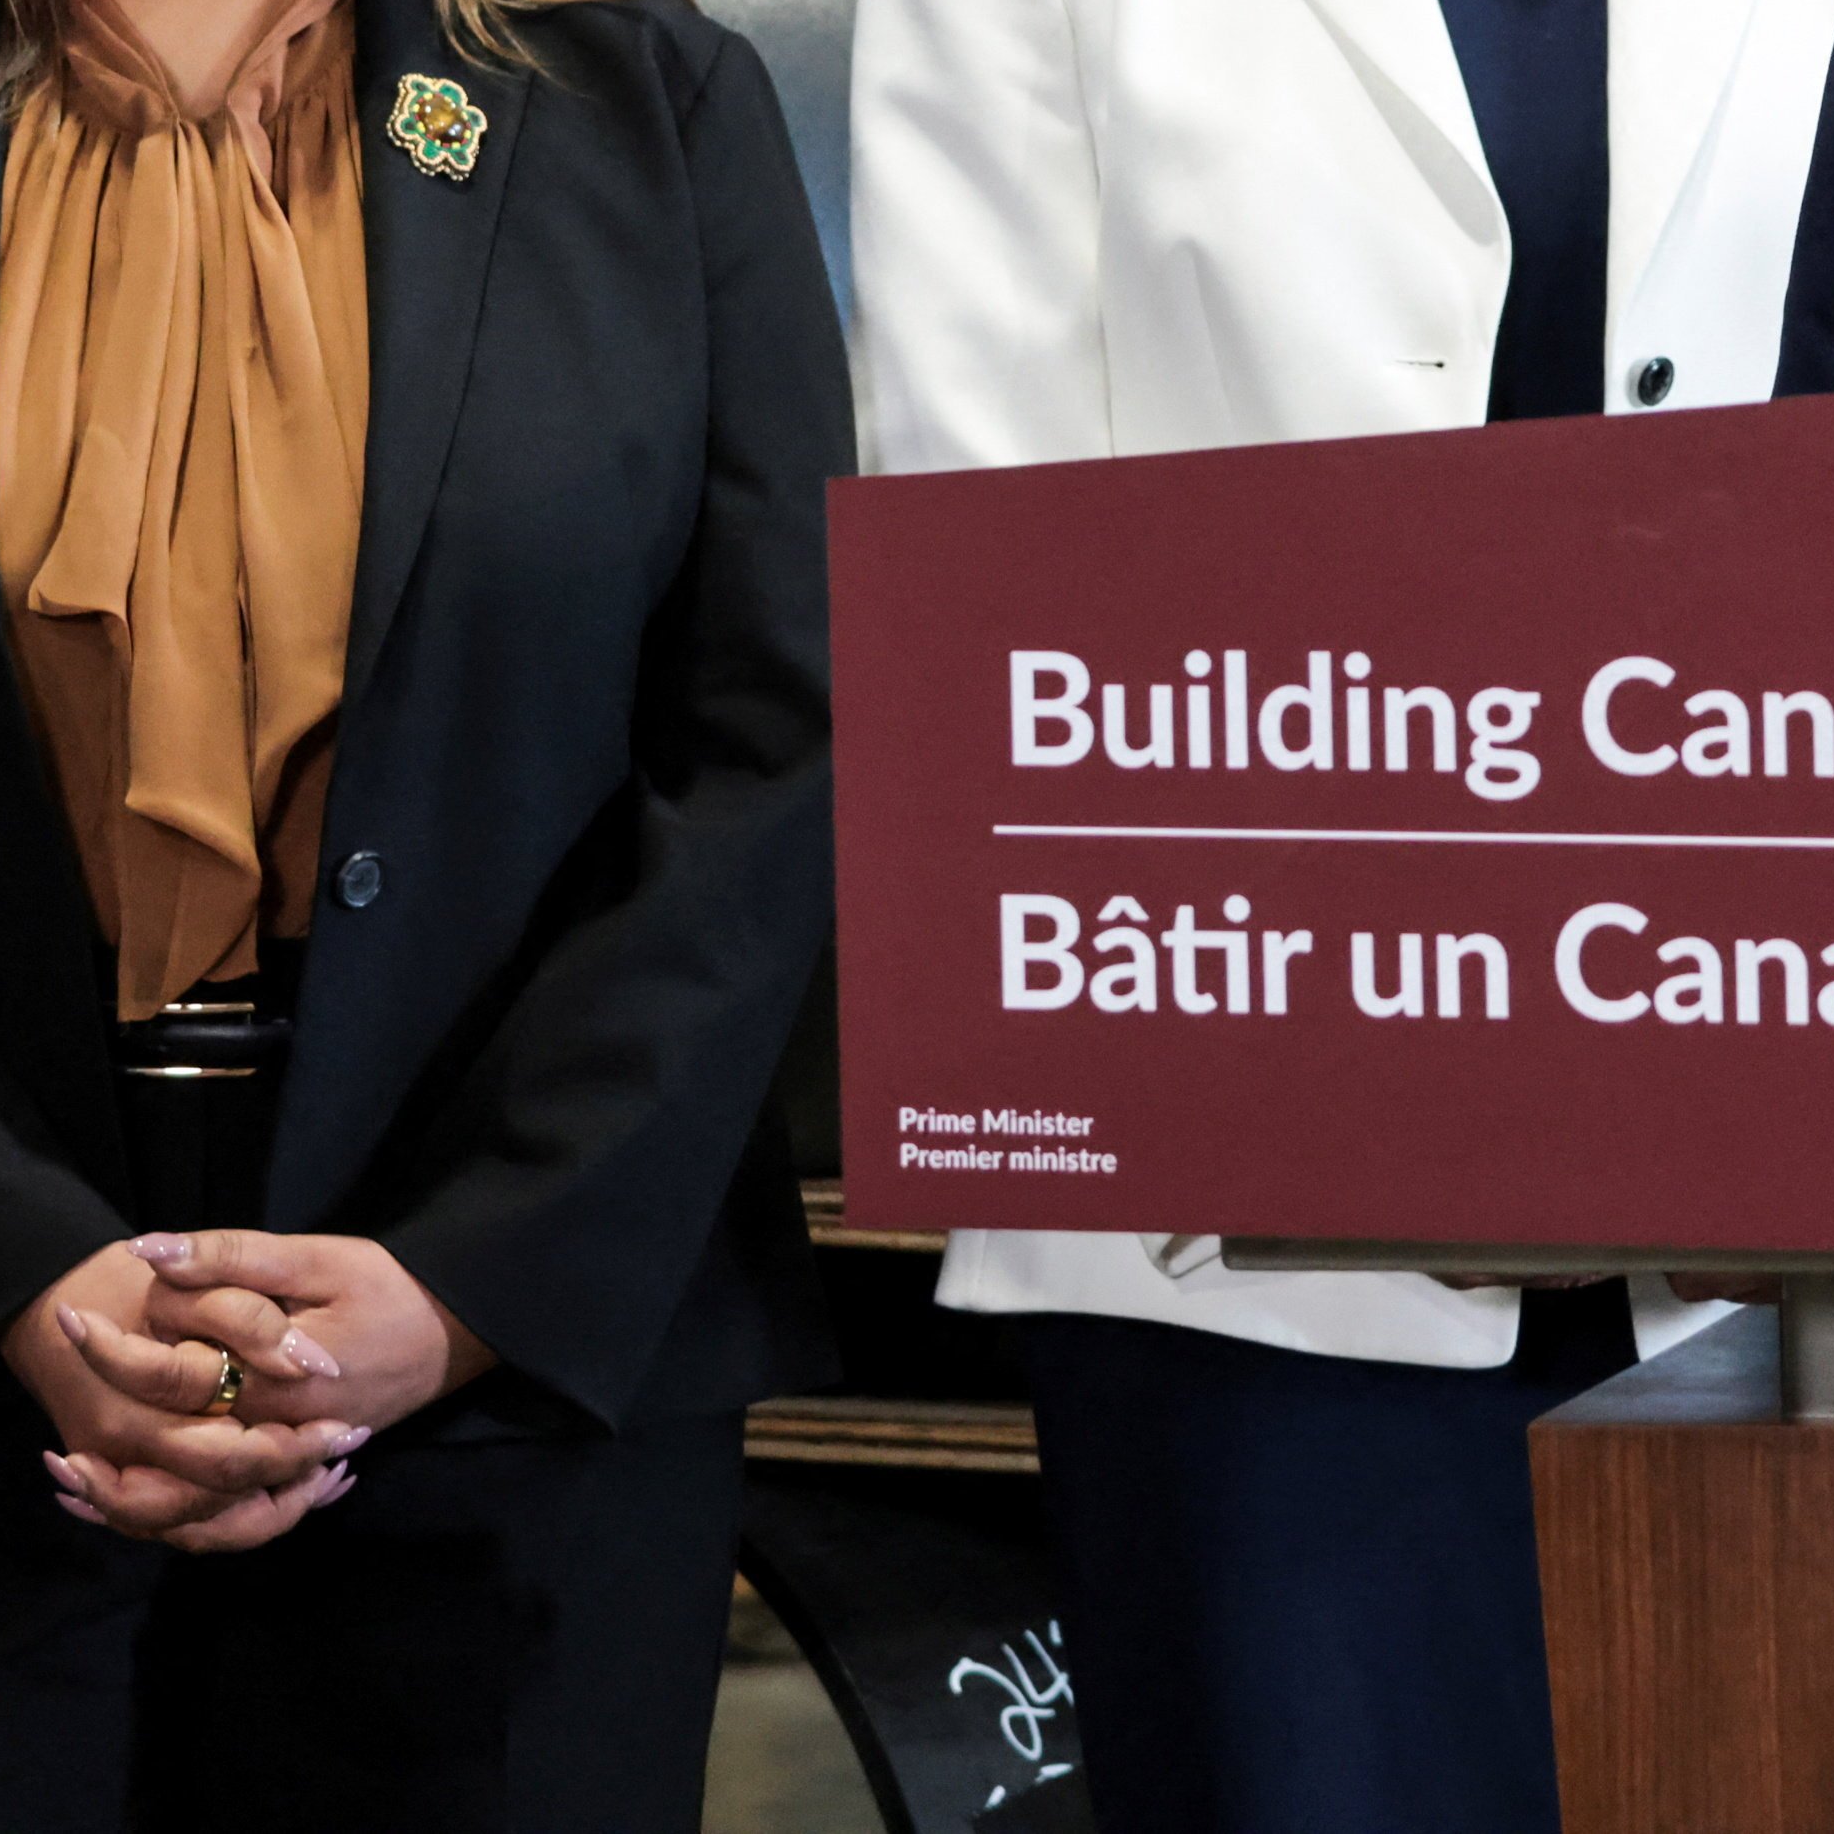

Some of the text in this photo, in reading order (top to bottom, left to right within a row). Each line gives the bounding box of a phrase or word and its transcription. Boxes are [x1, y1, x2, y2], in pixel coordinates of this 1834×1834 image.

[1008, 648, 1543, 803] Building
[998, 892, 1315, 1017] Bâtir
[1349, 931, 1511, 1021] un
[897, 1105, 1095, 1138] Prime Minister
[898, 1141, 1119, 1175] Premier ministre
